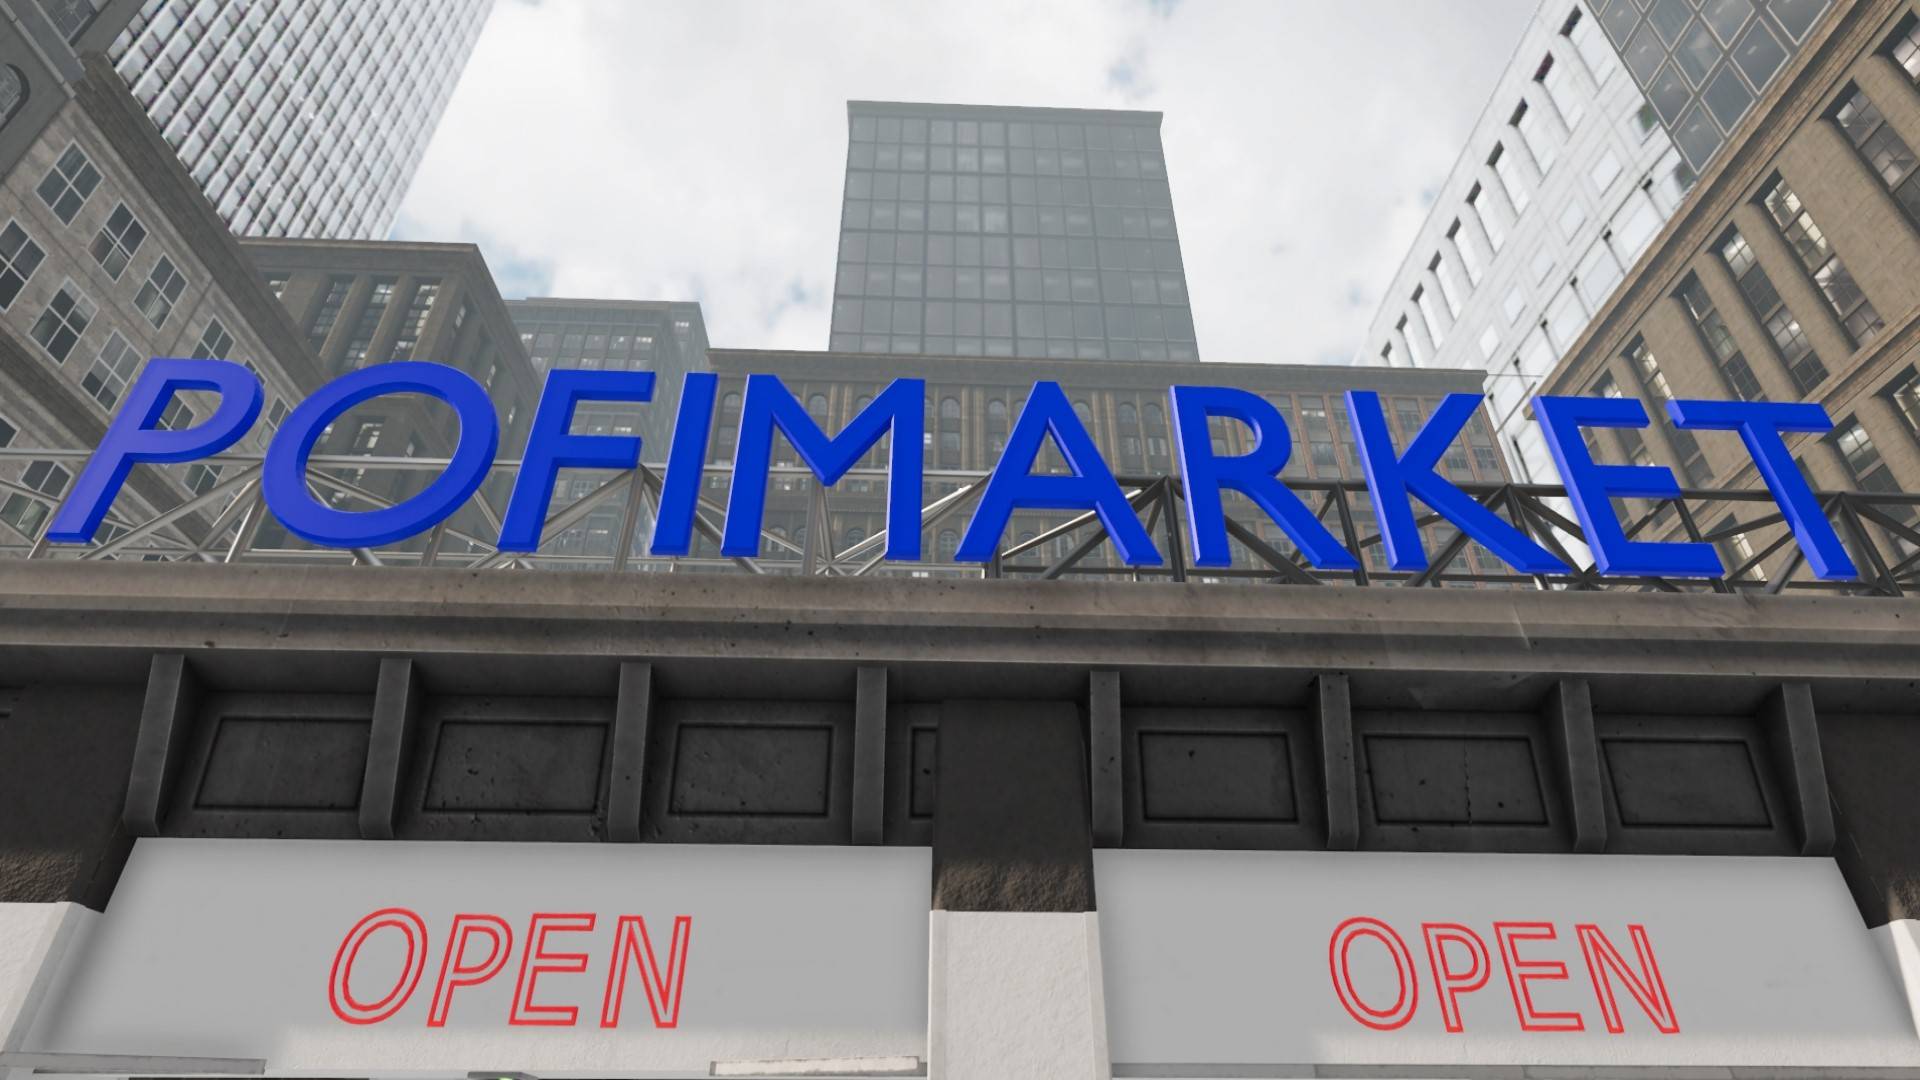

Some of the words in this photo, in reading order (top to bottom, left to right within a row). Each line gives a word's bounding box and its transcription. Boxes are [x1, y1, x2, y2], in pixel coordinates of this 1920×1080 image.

[46, 358, 1857, 581] POFIMARKET
[327, 907, 693, 1030] OPEN
[1328, 916, 1680, 1035] OPEN
